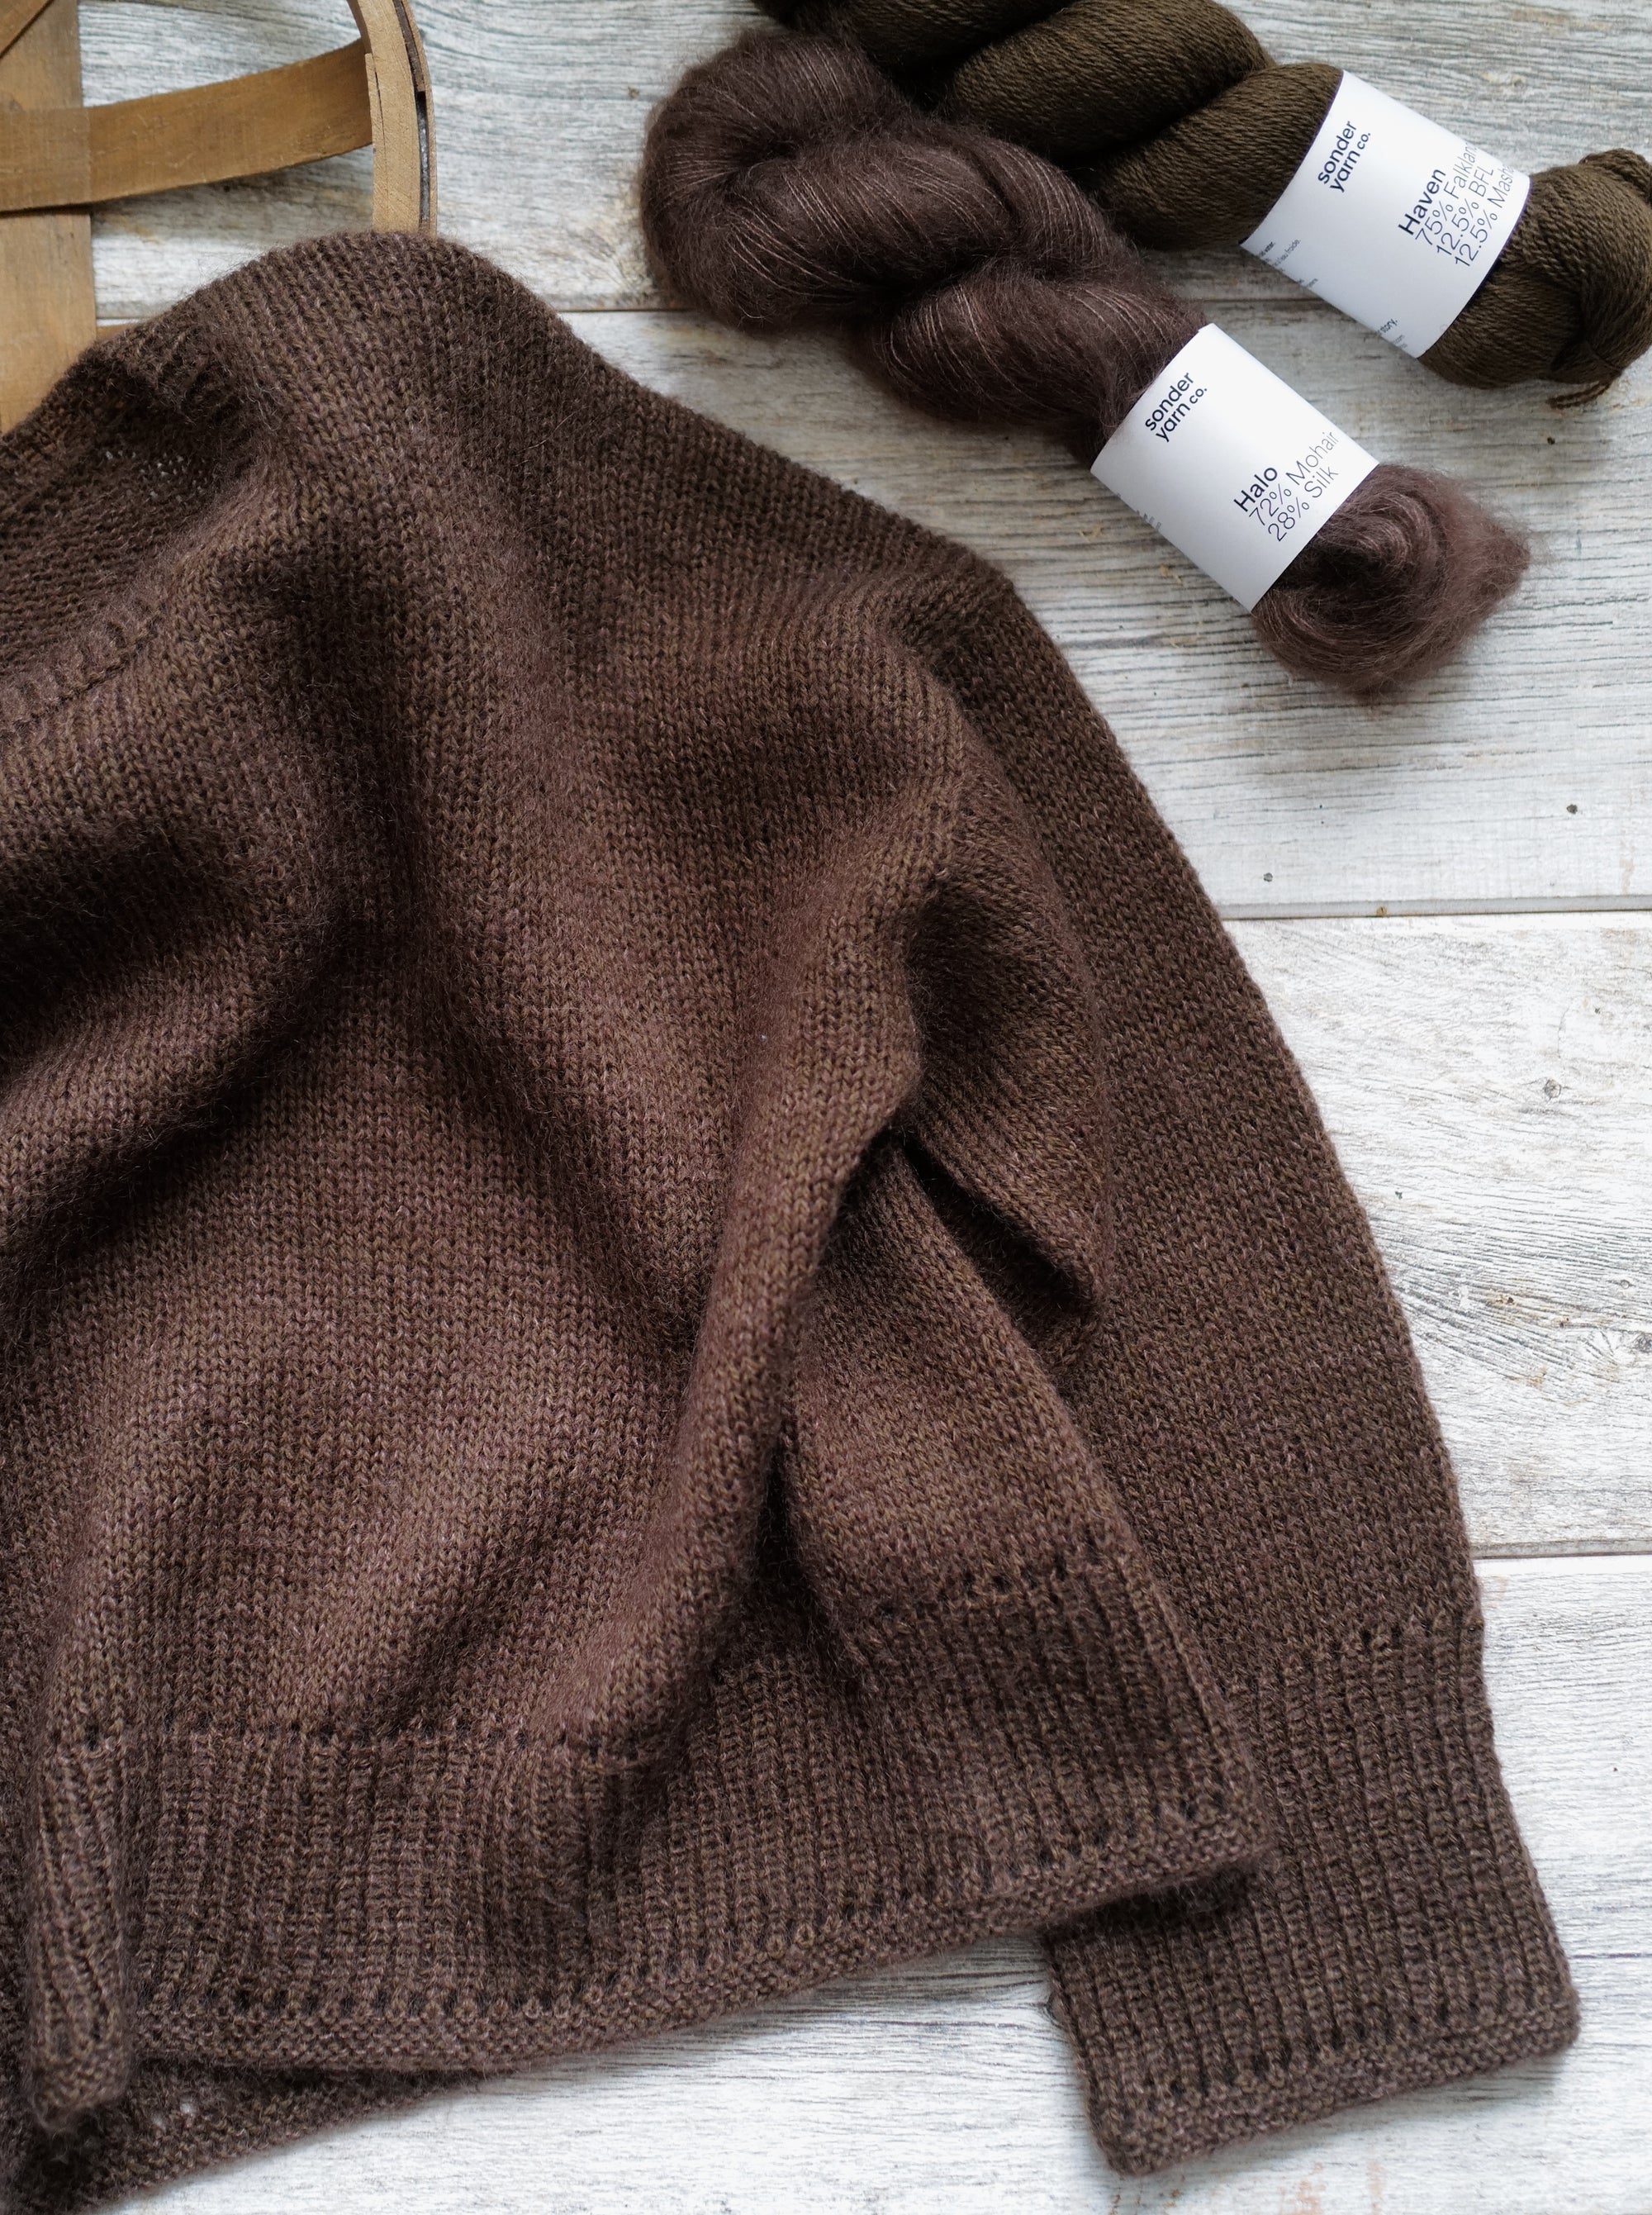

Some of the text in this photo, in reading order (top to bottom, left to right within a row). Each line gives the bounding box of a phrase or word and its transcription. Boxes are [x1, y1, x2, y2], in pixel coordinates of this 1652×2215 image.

[1317, 121, 1358, 184] sonder
[1330, 131, 1371, 193] yarn co.
[1398, 169, 1446, 235] Haven
[1415, 142, 1477, 246] 75% Falklan
[1436, 166, 1493, 257] 12.5% BFL
[1455, 209, 1498, 267] 12.5%
[1145, 372, 1194, 431] sonder
[1156, 387, 1208, 443] yarn co.
[1233, 467, 1277, 512] Halo
[1248, 430, 1340, 525] 72% Mohair
[1267, 467, 1339, 542] 28% Silk
